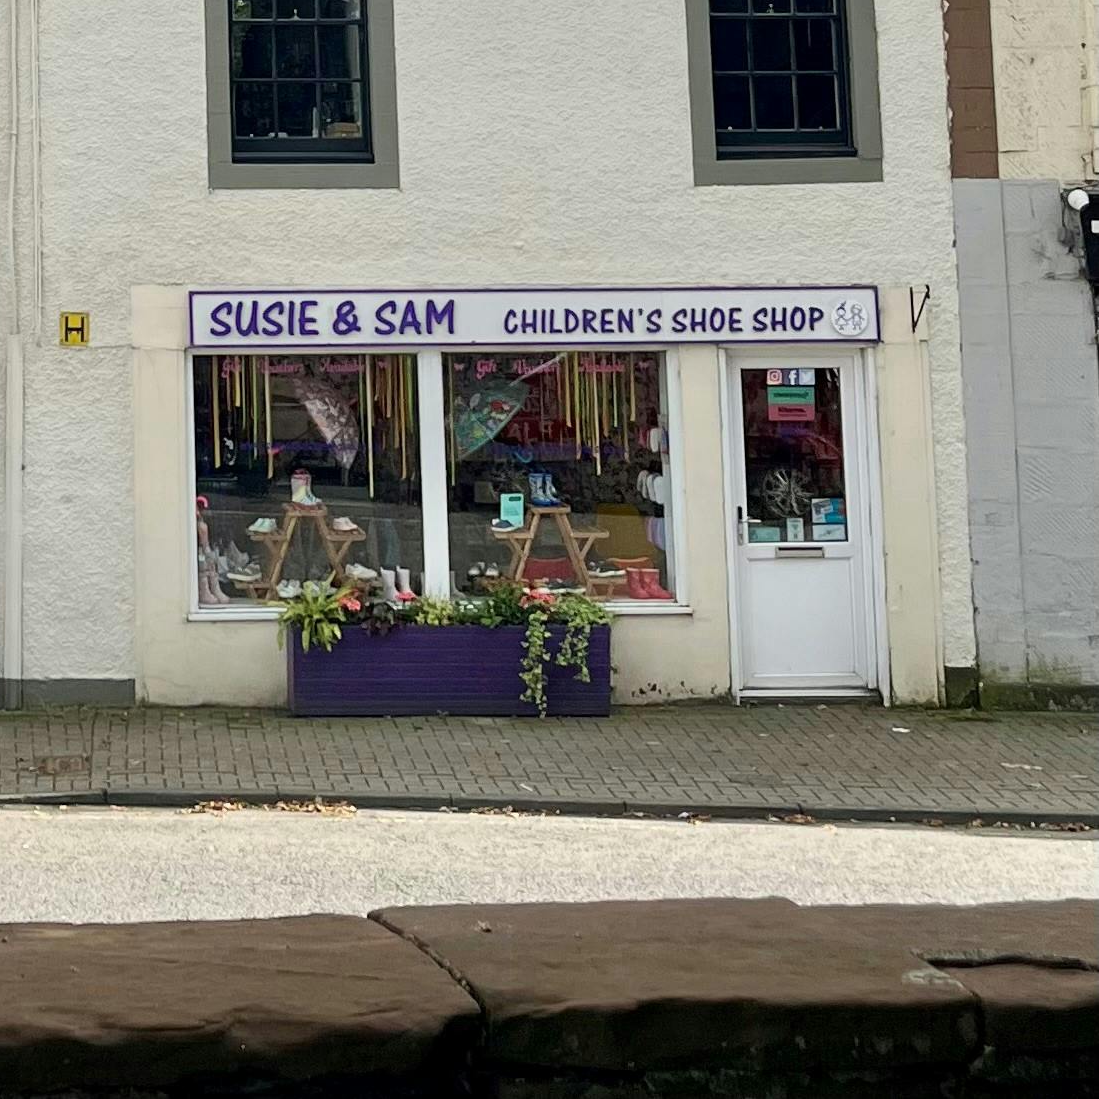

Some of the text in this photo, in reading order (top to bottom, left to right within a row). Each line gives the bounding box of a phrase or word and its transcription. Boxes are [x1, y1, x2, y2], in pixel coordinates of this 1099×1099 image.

[64, 316, 85, 343] H
[209, 299, 455, 337] SUSIE & SAM
[503, 306, 824, 334] CHILDREN'S SHOE SHOP
